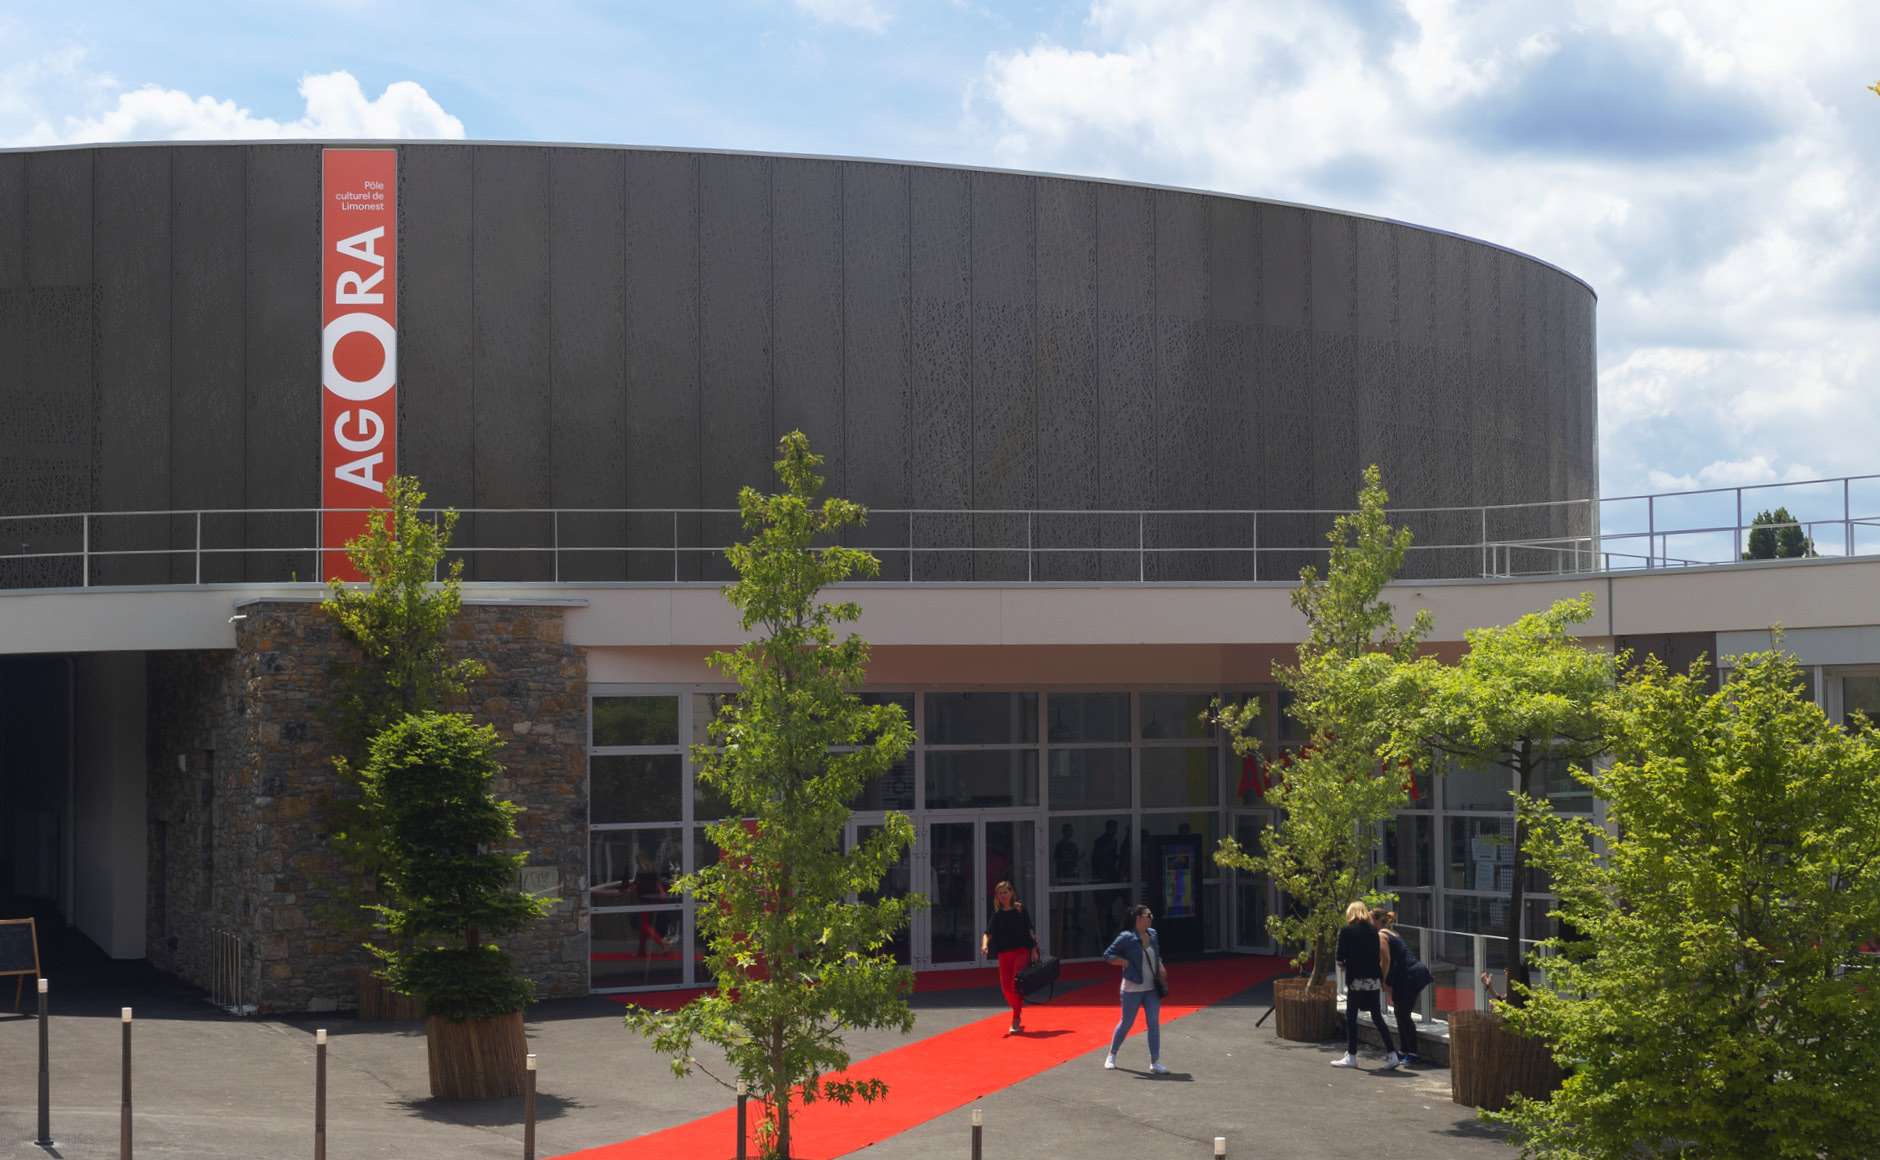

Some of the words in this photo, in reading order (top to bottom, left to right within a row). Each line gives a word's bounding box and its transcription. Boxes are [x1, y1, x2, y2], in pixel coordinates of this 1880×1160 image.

[364, 181, 385, 190] Pôle
[335, 191, 371, 200] culturel
[372, 191, 385, 200] de
[341, 201, 385, 211] Limonest
[323, 225, 397, 493] AGORA
